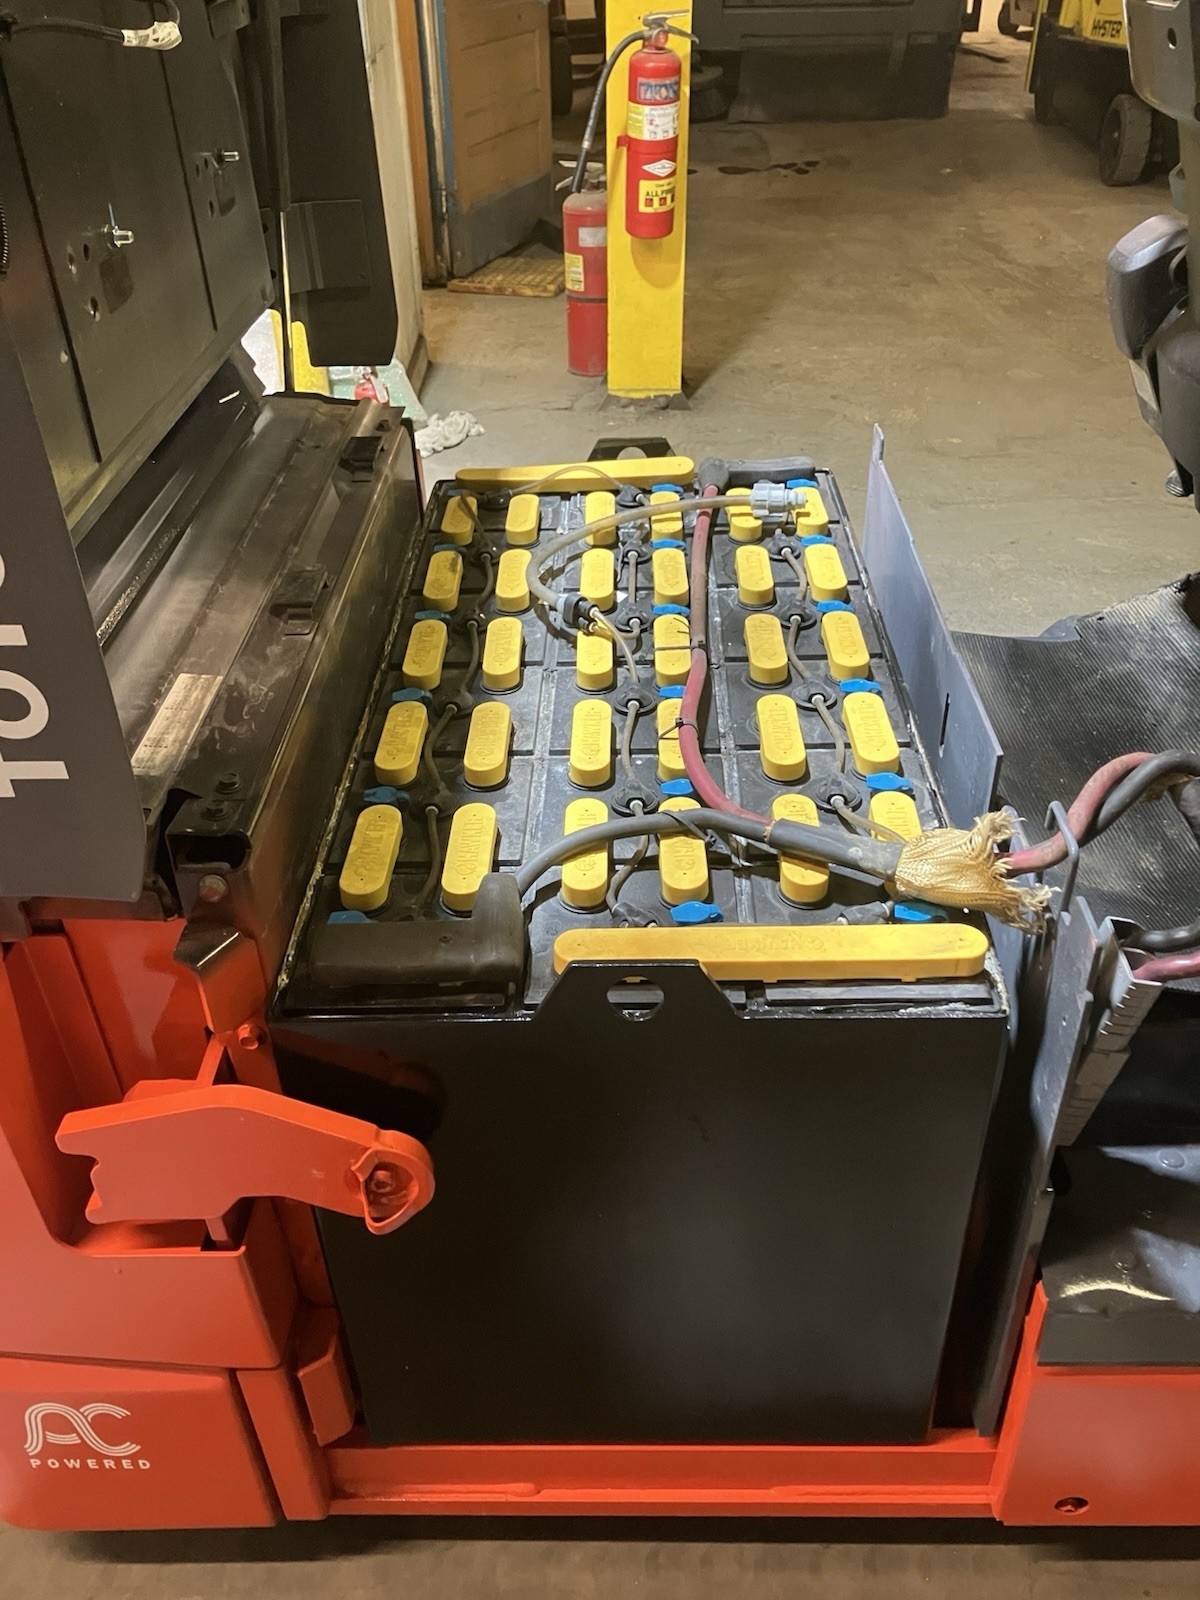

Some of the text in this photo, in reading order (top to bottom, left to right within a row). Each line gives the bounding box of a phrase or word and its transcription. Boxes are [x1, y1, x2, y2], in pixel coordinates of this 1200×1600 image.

[1091, 19, 1122, 38] HYSTER
[24, 1402, 141, 1456] AC
[29, 1458, 151, 1469] POWERED
